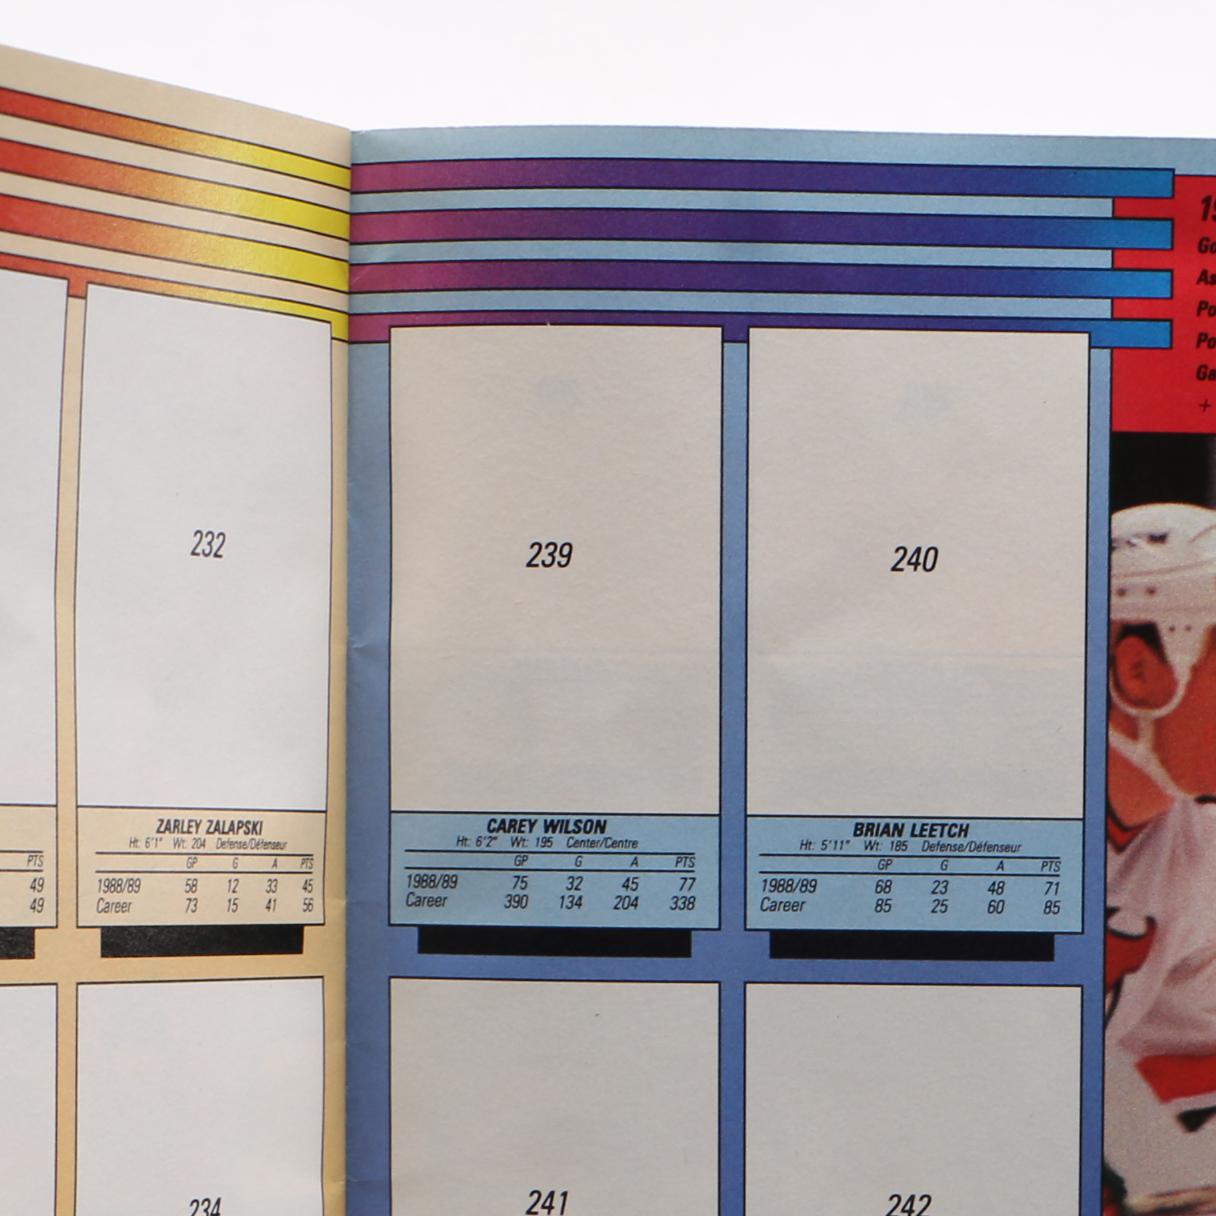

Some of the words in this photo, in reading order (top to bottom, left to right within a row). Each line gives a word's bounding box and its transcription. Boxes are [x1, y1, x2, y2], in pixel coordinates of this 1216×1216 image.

[190, 529, 227, 559] 232
[526, 541, 574, 569] 239
[891, 546, 938, 574] 240
[156, 819, 201, 835] ZARLEY
[206, 820, 263, 836] ZALAPSKI
[487, 818, 537, 833] CAREY
[543, 819, 607, 834] WILSON
[853, 823, 904, 837] BRIAN
[910, 823, 969, 838] LEETCH
[97, 878, 140, 893] 1988/89
[185, 879, 198, 892] 58
[228, 879, 238, 893] 12
[266, 879, 278, 892] 33
[302, 879, 313, 892] 45
[407, 874, 458, 888] 1988/89
[512, 876, 528, 889] 75
[566, 877, 583, 890] 32
[622, 878, 639, 891] 45
[680, 878, 696, 891] 77
[761, 879, 817, 892] 1988/89
[875, 881, 892, 894] 68
[931, 881, 948, 895] 23
[987, 882, 1005, 895] 48
[1045, 882, 1059, 895] 71
[406, 894, 447, 907] Career
[504, 895, 528, 908] 390
[559, 896, 583, 909] 134
[613, 897, 639, 910] 204
[670, 897, 696, 910] 338
[526, 1189, 570, 1216] 241
